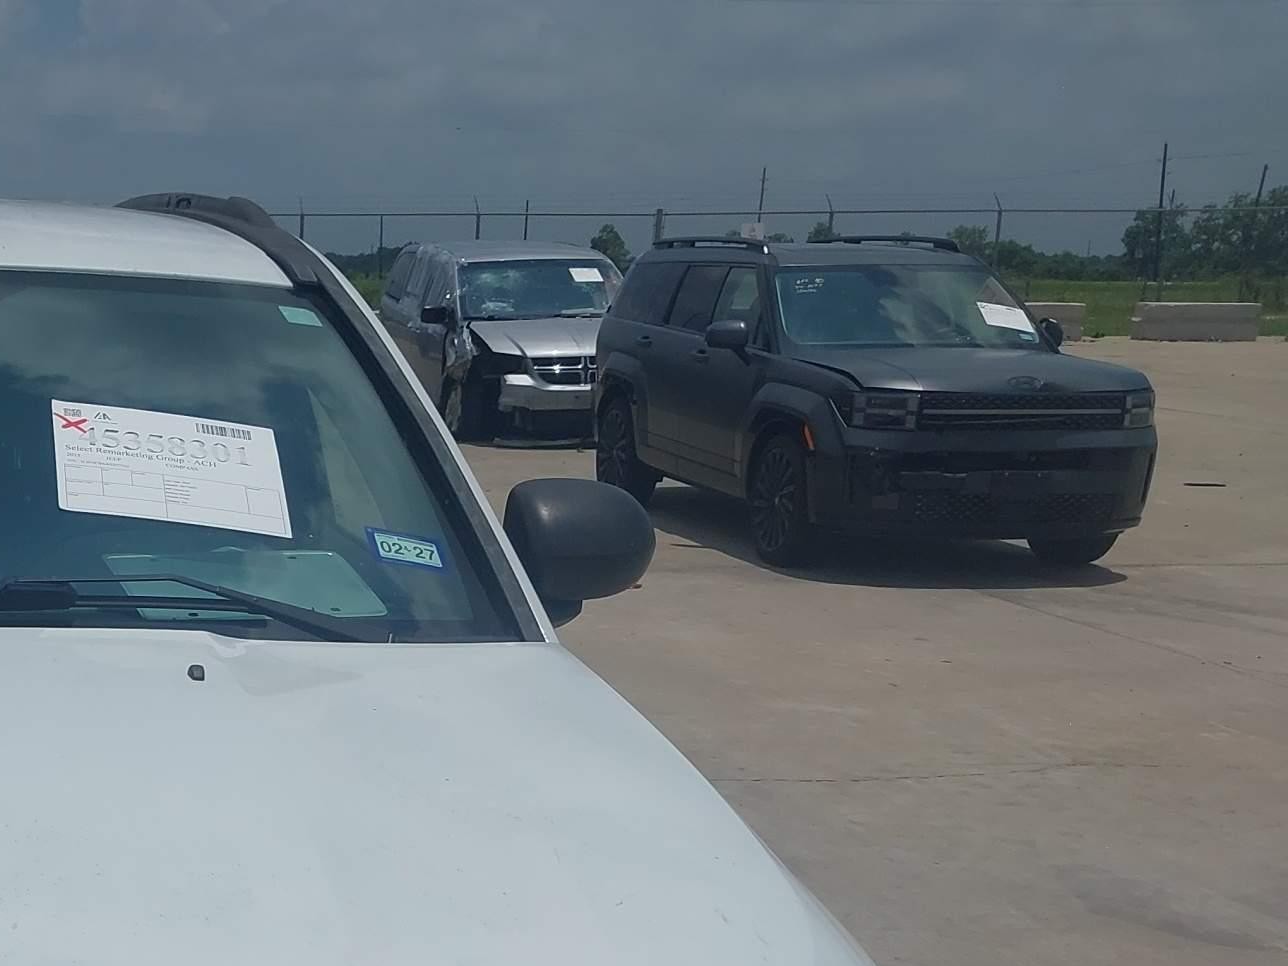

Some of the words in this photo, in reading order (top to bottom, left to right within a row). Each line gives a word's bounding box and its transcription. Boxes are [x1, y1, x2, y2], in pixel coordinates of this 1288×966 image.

[65, 444, 93, 453] Select
[96, 447, 153, 461] Remarketing
[156, 454, 185, 464] Group
[194, 460, 217, 468] ACH
[79, 426, 253, 466] 45358301
